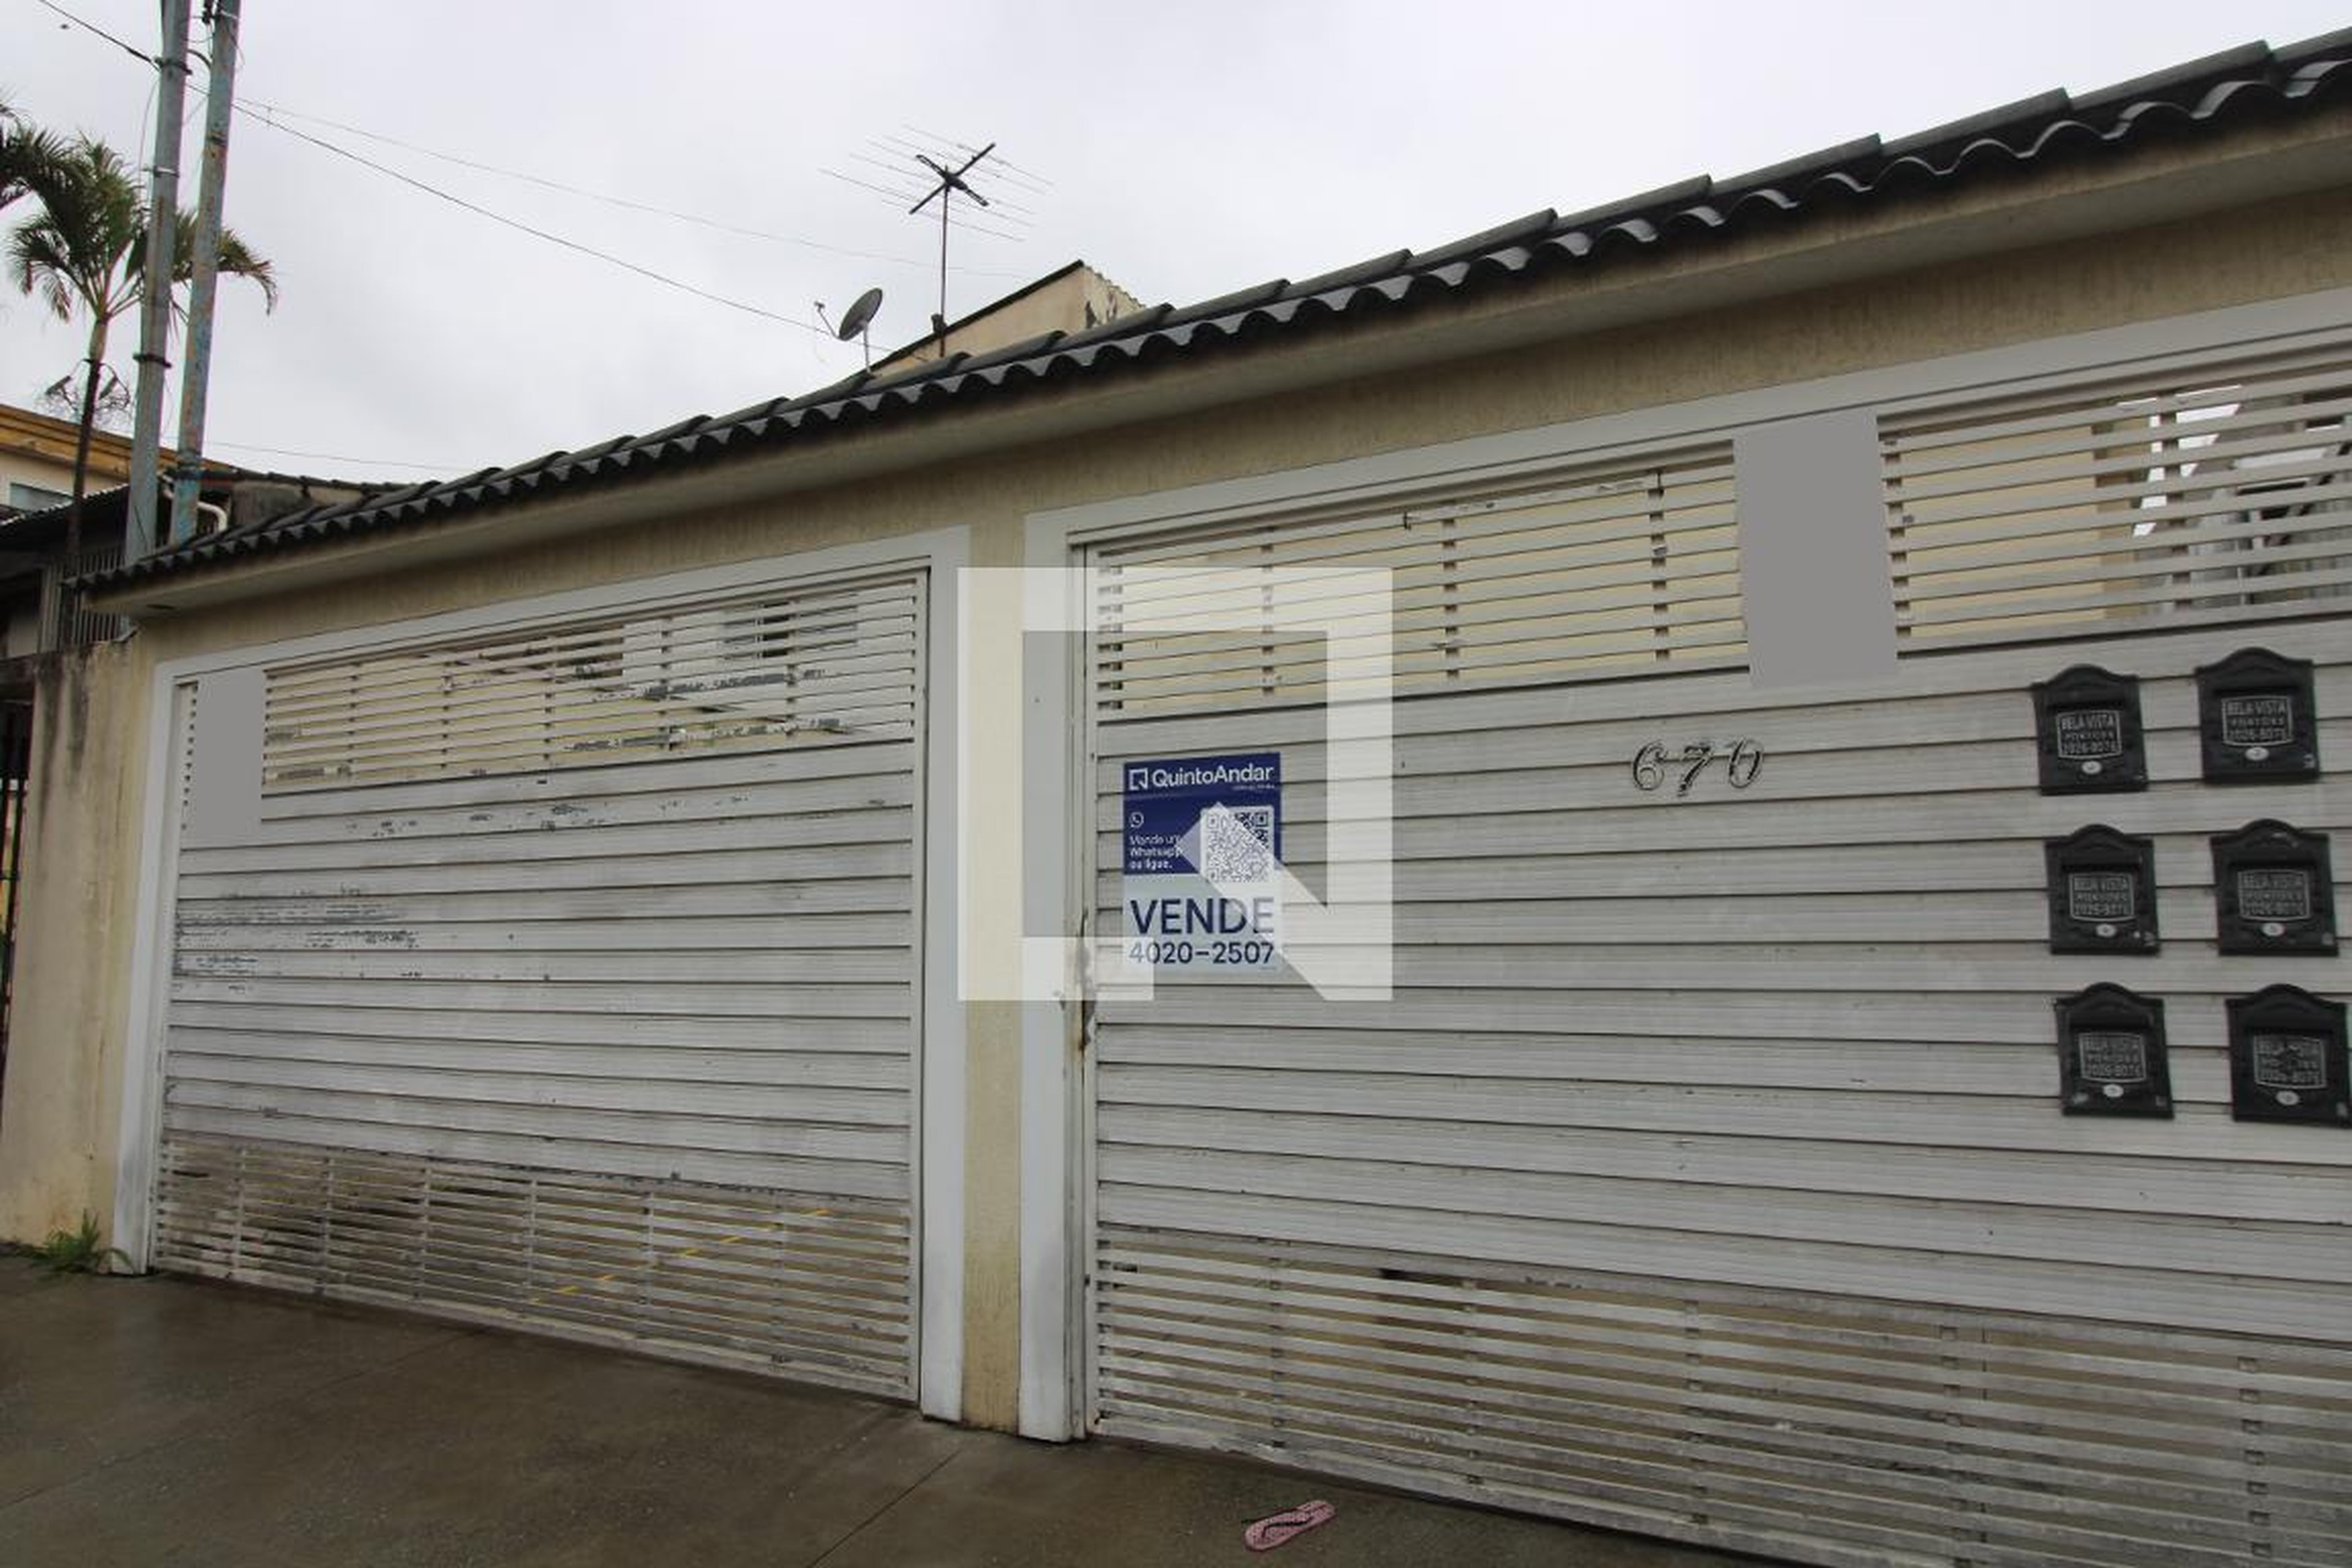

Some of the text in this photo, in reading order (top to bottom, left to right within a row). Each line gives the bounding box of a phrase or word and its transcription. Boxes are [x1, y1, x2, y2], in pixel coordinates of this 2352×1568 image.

[2226, 701, 2252, 715] BELA
[2062, 715, 2085, 729] BELA
[1152, 763, 1274, 787] QuintoAndar
[1633, 737, 1765, 797] 670
[1130, 896, 1275, 935] VENDE
[1129, 941, 1275, 965] 4020-2507
